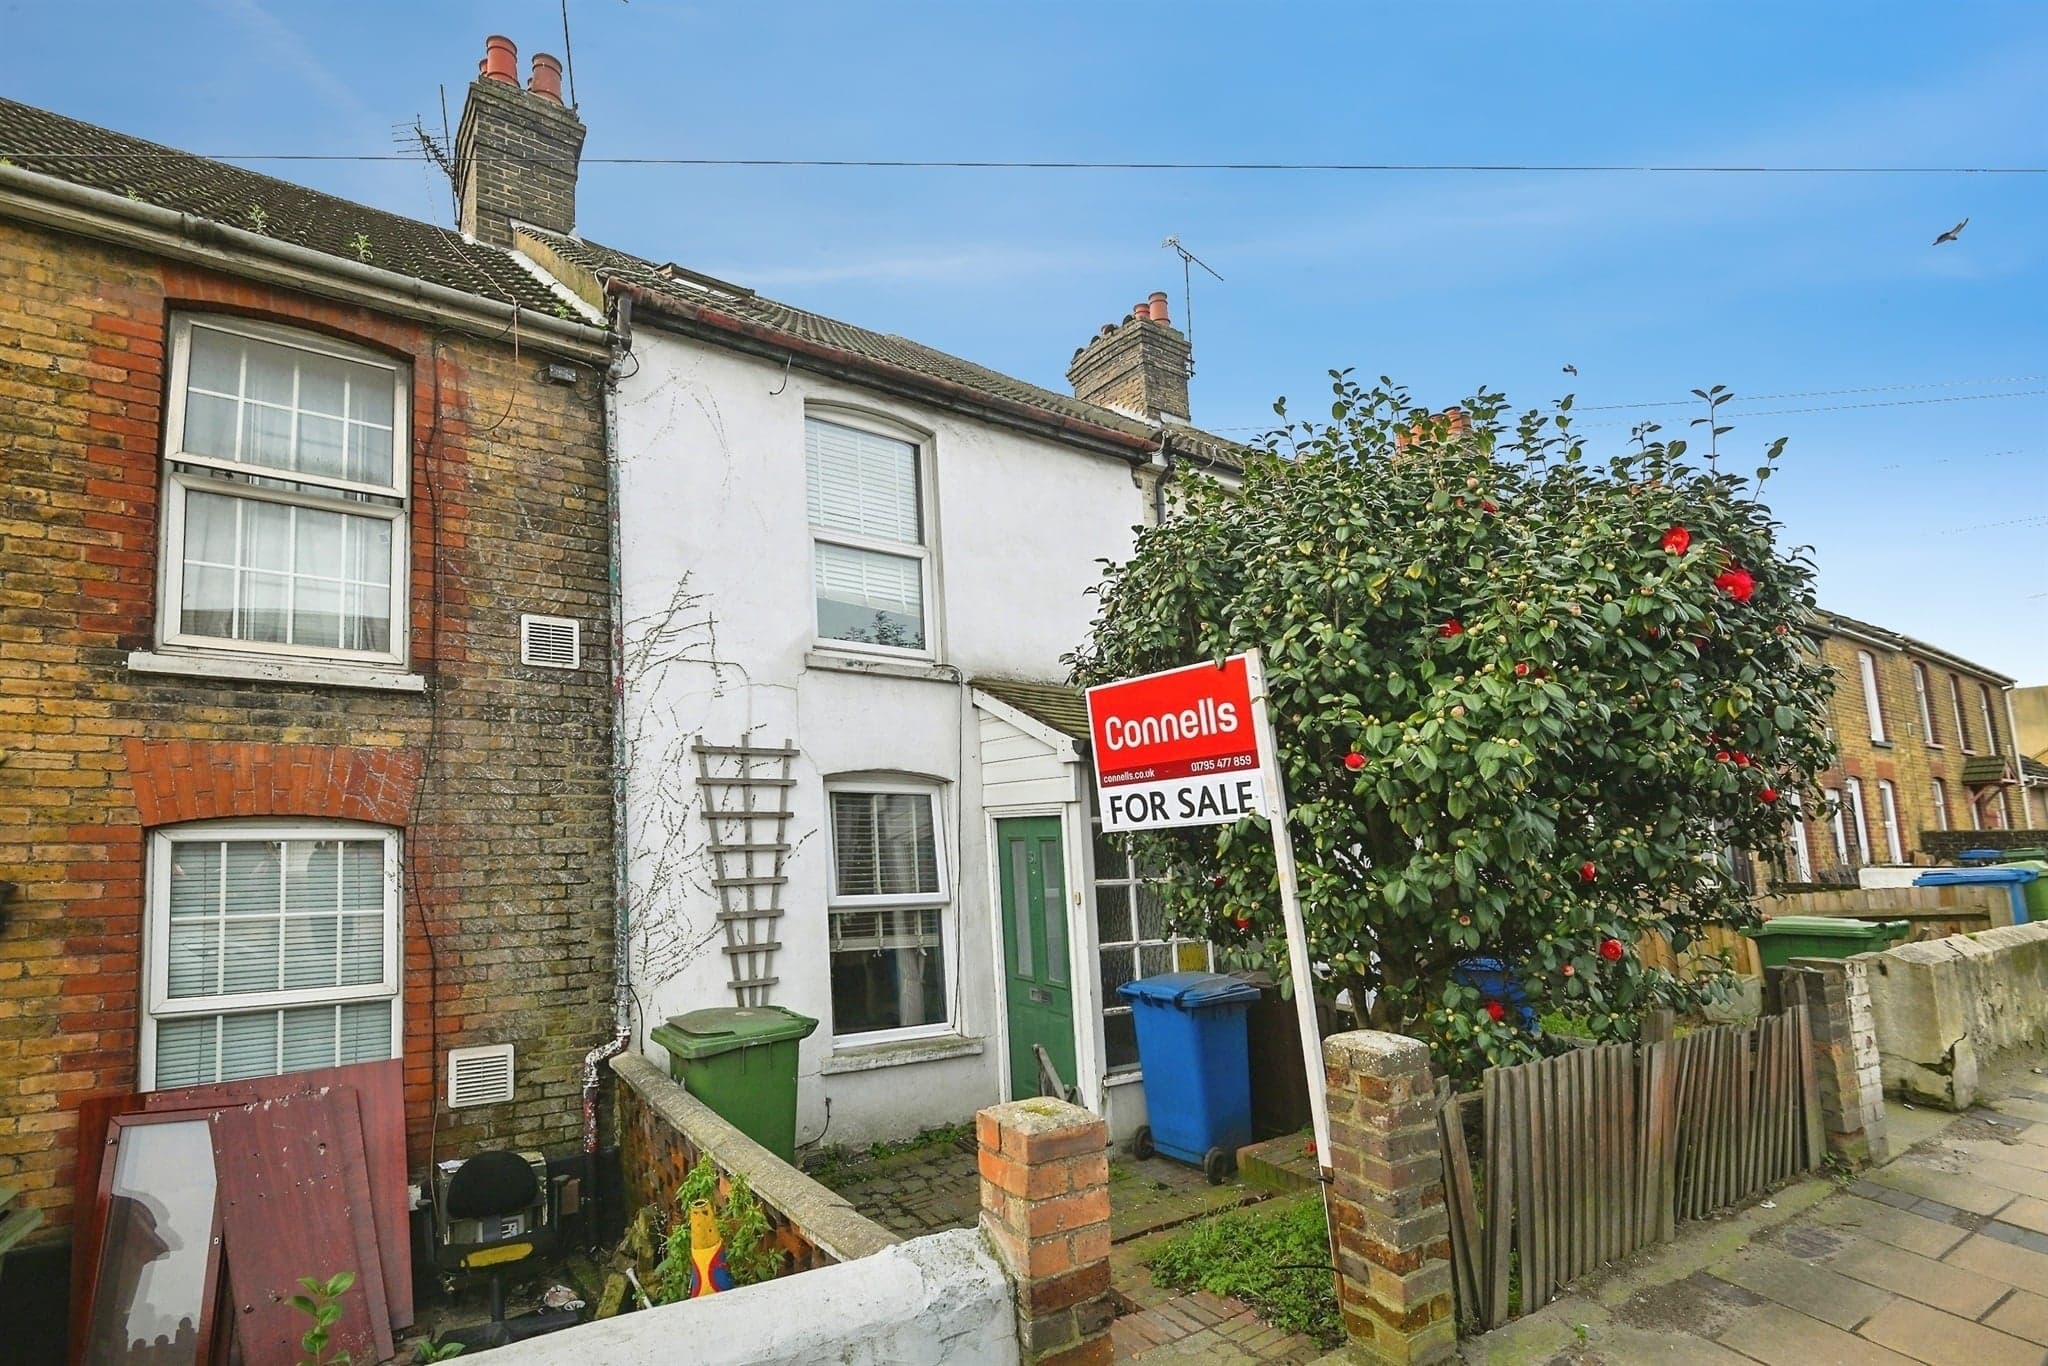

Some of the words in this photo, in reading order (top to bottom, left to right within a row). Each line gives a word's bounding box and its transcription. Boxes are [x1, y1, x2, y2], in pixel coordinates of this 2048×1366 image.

[1105, 697, 1239, 751] Connells
[1103, 767, 1155, 784] connells.co.uk
[1191, 760, 1215, 773] 01795
[1217, 757, 1232, 769] 477
[1233, 755, 1252, 767] 859
[1109, 791, 1170, 825] FOR
[1177, 781, 1255, 820] SALE
